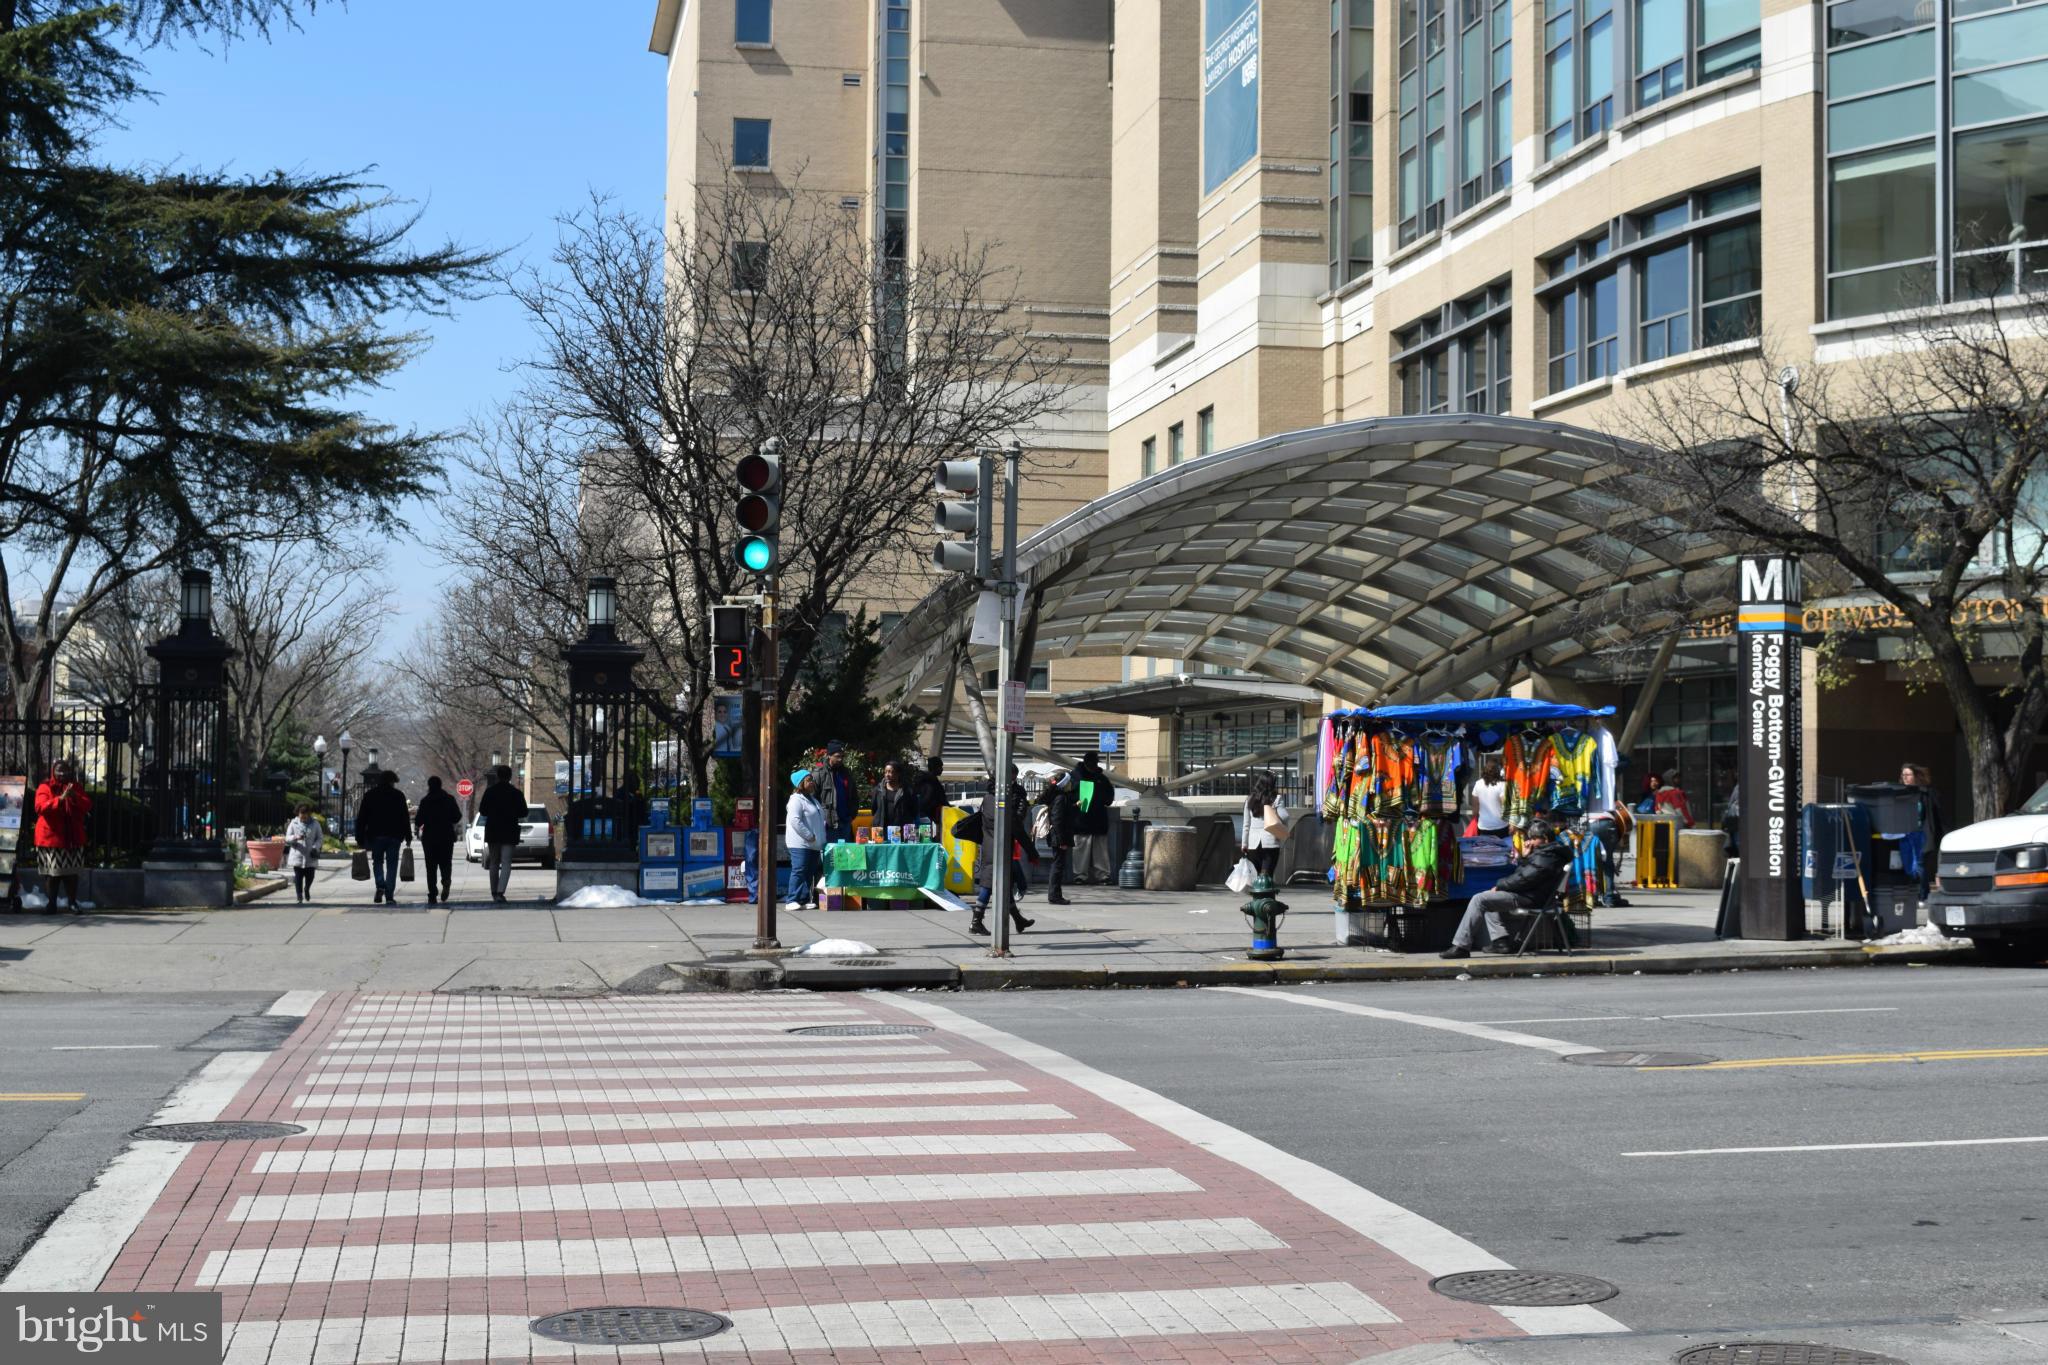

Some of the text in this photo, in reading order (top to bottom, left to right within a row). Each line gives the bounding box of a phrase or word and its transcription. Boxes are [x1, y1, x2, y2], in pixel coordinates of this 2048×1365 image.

[1205, 28, 1257, 88] UNIVERSITY HOSPITAL
[1741, 559, 1783, 601] M
[1785, 560, 1801, 602] M
[730, 648, 742, 677] 2
[1750, 634, 1766, 748] Kennedy Center
[1764, 633, 1785, 877] Foggy Bottom-GWU Station
[459, 784, 473, 792] STOP
[868, 870, 885, 879] Girl
